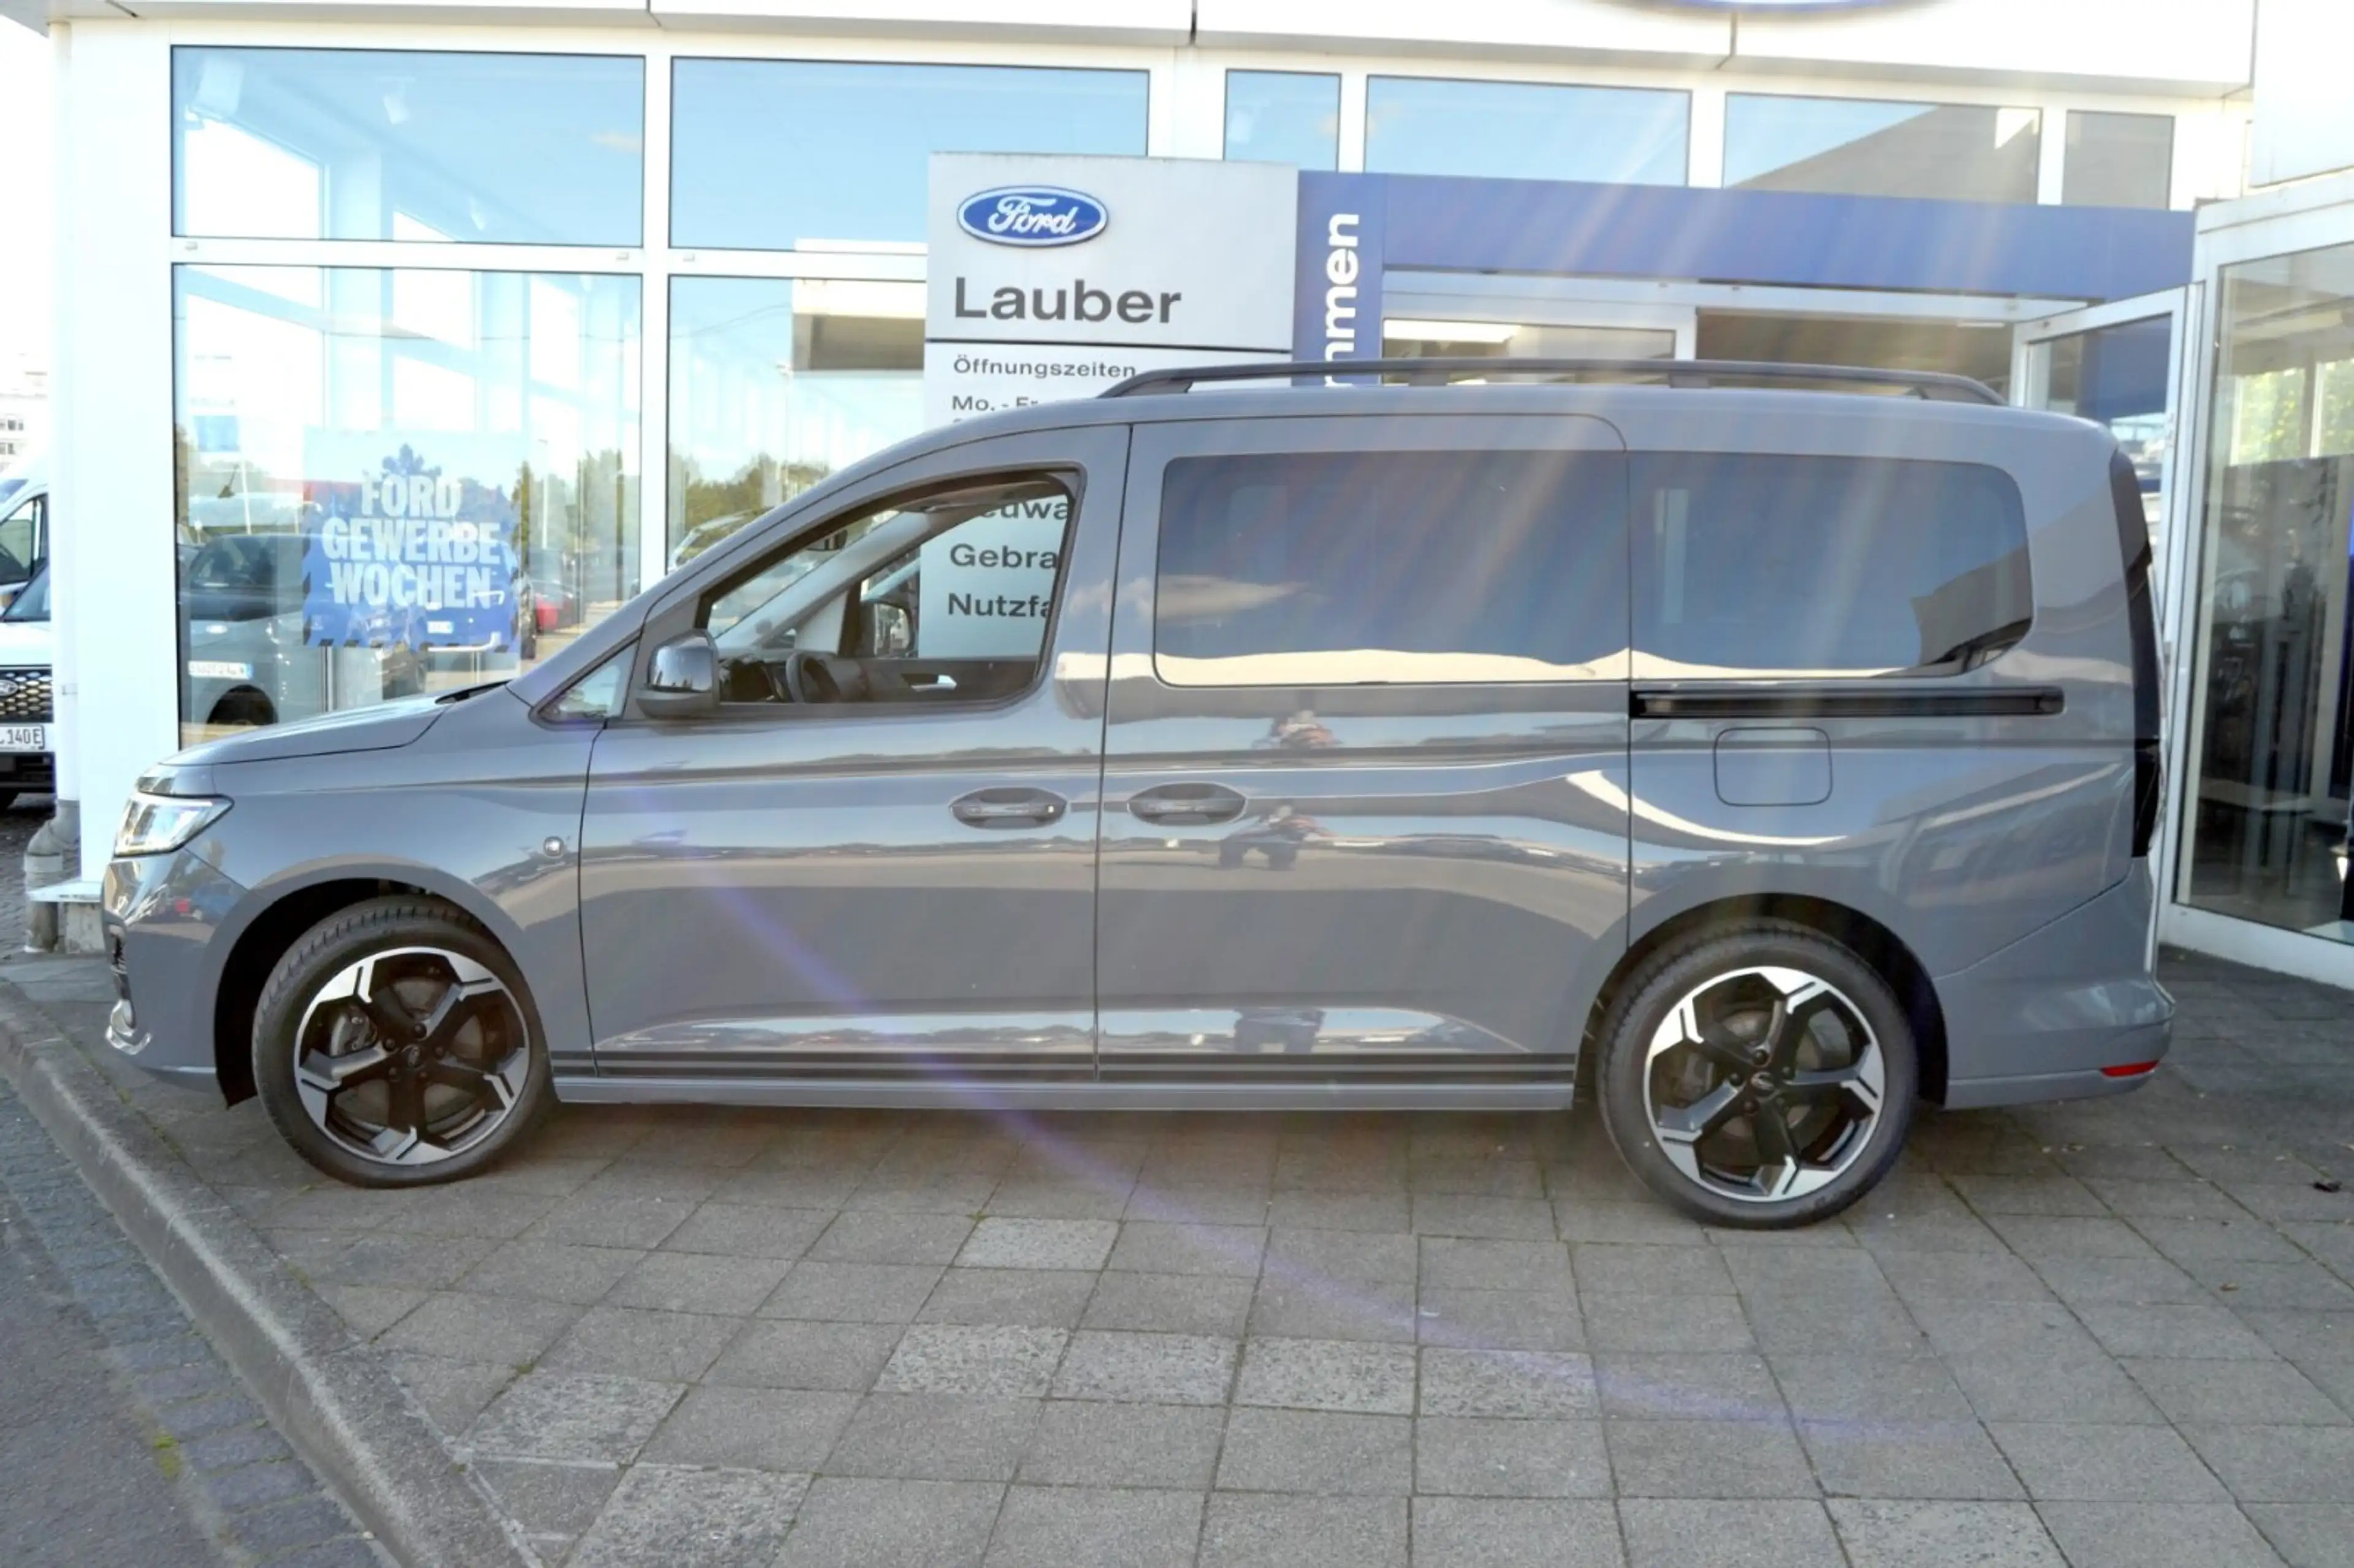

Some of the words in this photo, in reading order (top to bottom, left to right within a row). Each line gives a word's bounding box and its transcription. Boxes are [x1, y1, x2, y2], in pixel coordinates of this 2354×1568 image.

[988, 195, 1080, 234] Ford
[955, 276, 1182, 324] Lauber
[953, 354, 1136, 379] Öffnungszeiten
[952, 395, 996, 412] Mo.
[360, 474, 462, 518] FORD
[321, 516, 501, 565] GEWERBE
[950, 543, 1059, 569] Gebra
[329, 561, 492, 609] WOCHEN
